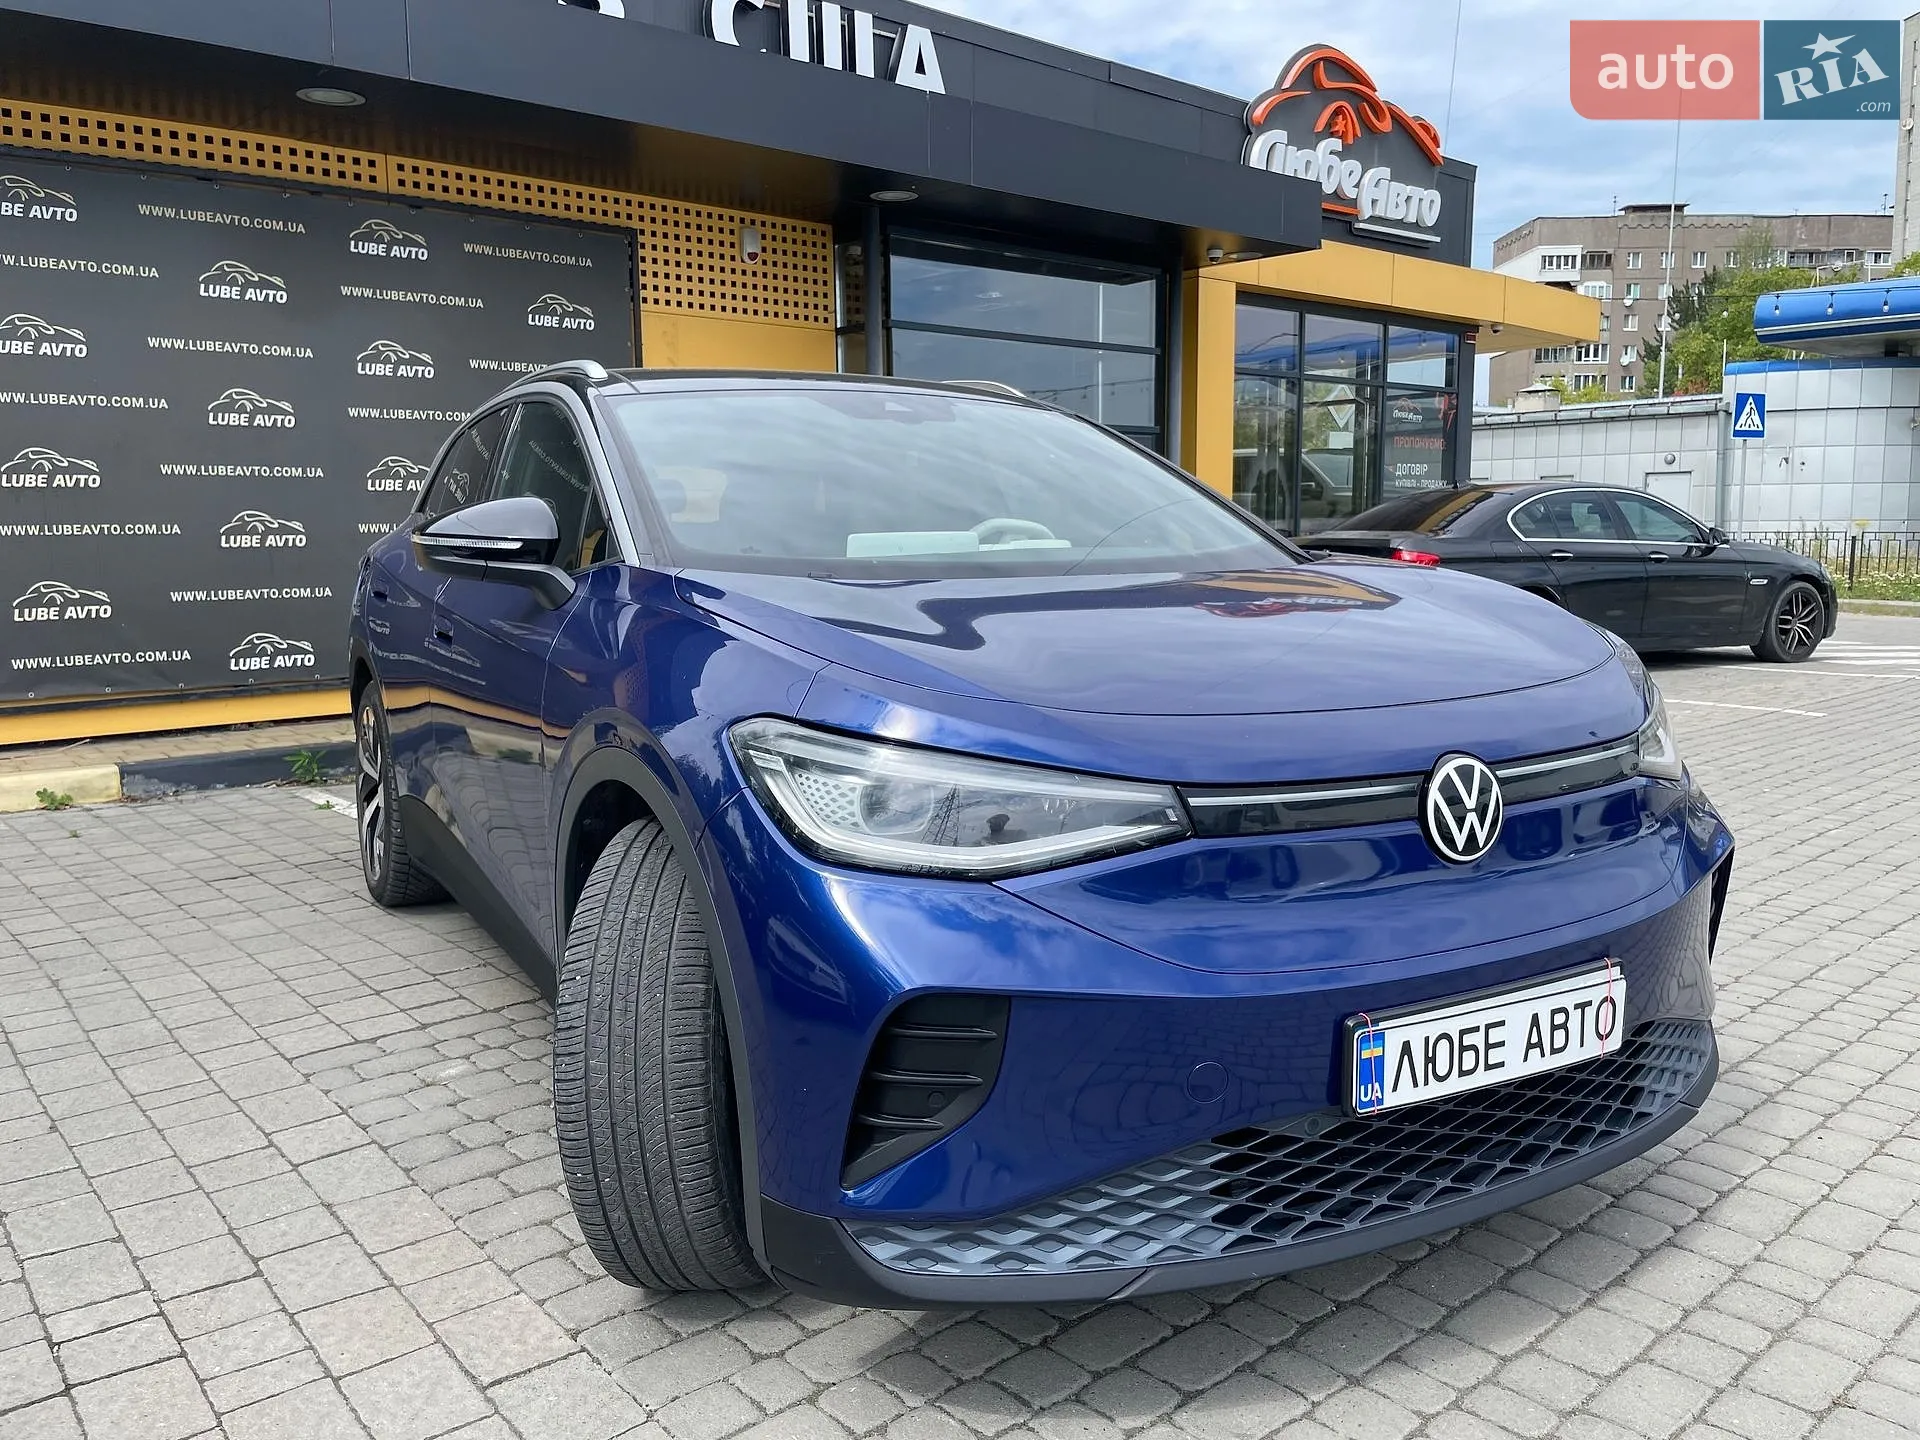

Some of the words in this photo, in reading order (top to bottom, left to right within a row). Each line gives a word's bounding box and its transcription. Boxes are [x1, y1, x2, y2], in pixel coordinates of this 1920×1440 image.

[1, 202, 24, 216] BE
[29, 205, 77, 221] AVTO
[139, 205, 305, 233] WWW.LUBEAVTO.COM.UA
[351, 241, 387, 256] LUBE
[391, 246, 427, 260] AVTO
[464, 244, 592, 266] WWW.LUBEAVTO.COM.UA
[0, 254, 159, 277] W.LUBEAVTO.COM.UA
[200, 284, 241, 299] LUBE
[245, 288, 287, 303] AVTO
[341, 286, 483, 308] WWW.LUBEAVTO.COM.UA
[528, 314, 560, 327] LUBE
[563, 317, 594, 330] AVTO
[0, 340, 34, 354] UBE
[39, 343, 87, 357] AVTO
[148, 337, 313, 358] WWW.LUBEAVTO.COM.UA
[358, 363, 394, 376] LUBE
[397, 365, 434, 378] AVTO
[0, 392, 168, 408] WW.LUBEAVTO.COM.UA
[209, 413, 250, 426] LUBE
[253, 415, 295, 427] AVTO
[348, 408, 470, 424] WWW.LUBEAVTO.COM
[160, 464, 323, 477] WWW.LUBEAVTO.COM.UA
[1395, 463, 1428, 477] ДОГОВІР
[2, 474, 48, 487] LUBE
[53, 475, 100, 487] AVTO
[368, 479, 403, 491] LUBE
[407, 480, 425, 492] AV
[0, 524, 181, 536] WWW.LUBEAVTO.COM.UA
[221, 535, 261, 547] LUBE
[265, 535, 306, 547] AVTO
[170, 587, 332, 601] WWW.LUBEAVTO.COM.UA
[14, 607, 59, 621] LUBE
[64, 605, 111, 619] AVTO
[11, 650, 191, 669] WWW.LUBEAVTO.COM.UA
[230, 656, 270, 670] LUBE
[274, 654, 314, 667] AVTO
[1392, 1019, 1506, 1093] ЛЮБЕ
[1522, 995, 1617, 1063] АВТО
[1360, 1081, 1383, 1102] UA
